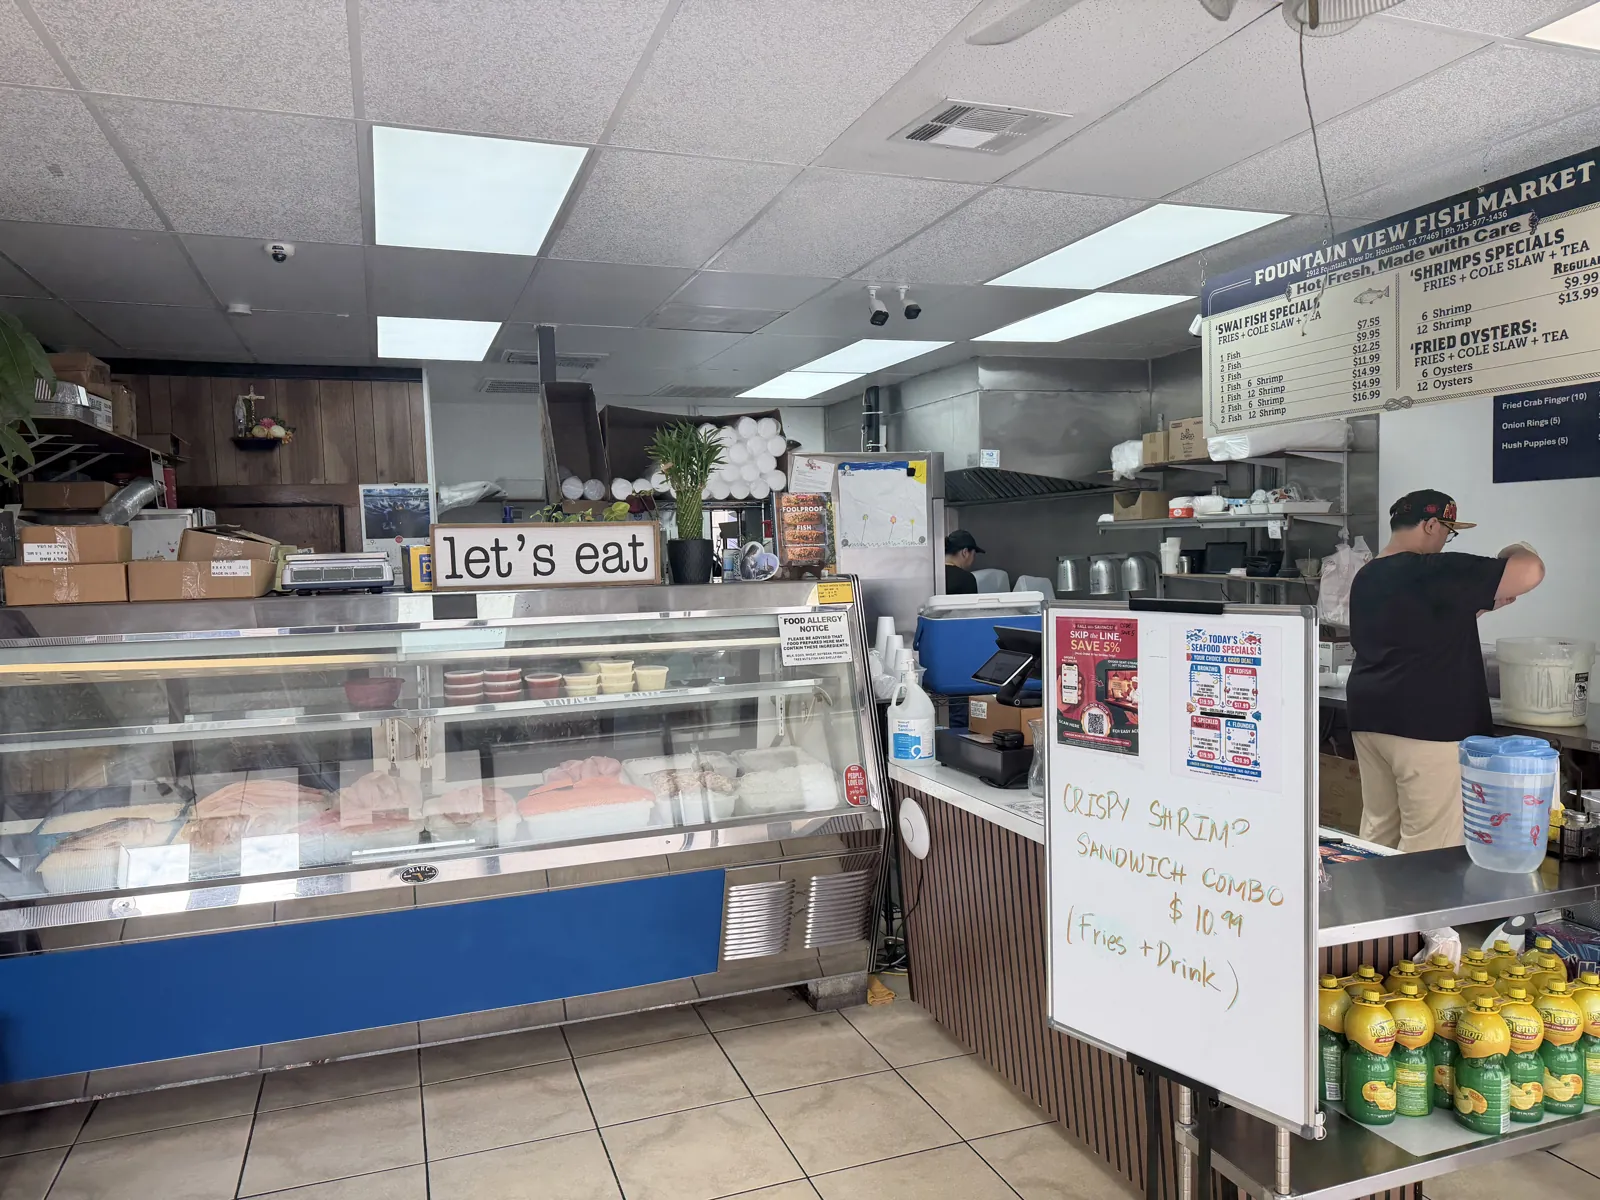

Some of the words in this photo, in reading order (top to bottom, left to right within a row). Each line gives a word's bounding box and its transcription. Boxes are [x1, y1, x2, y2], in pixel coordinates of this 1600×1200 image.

[1254, 241, 1348, 286] FOUNTAIN
[1352, 221, 1409, 254] VIEW
[1415, 200, 1472, 236] FISH
[1477, 160, 1596, 215] MARKET
[1306, 267, 1320, 278] 2912
[1348, 254, 1363, 265] View
[1408, 236, 1418, 246] TX
[1418, 231, 1440, 244] 77469
[1445, 226, 1456, 236] Ph
[1456, 210, 1508, 232] 713-977-1436
[1328, 264, 1376, 286] Fresh,
[1378, 247, 1425, 271] Made
[1429, 235, 1469, 255] with
[1474, 220, 1522, 243] Care
[1485, 228, 1565, 263] SPECIALS
[1423, 274, 1457, 292] FRIES
[1459, 275, 1467, 283] +
[1469, 262, 1504, 280] COLE
[1507, 251, 1545, 270] SLAW
[1549, 252, 1557, 260] +
[1561, 240, 1590, 257] TEA
[1416, 325, 1428, 335] 12
[1432, 315, 1472, 332] Shrimp
[1558, 286, 1599, 305] $13.99
[1421, 311, 1428, 321] 6
[1432, 302, 1472, 319] Shrimp
[1564, 271, 1599, 290] $9.99
[1218, 332, 1239, 346] FRIES
[1247, 324, 1269, 338] COLE
[1271, 317, 1294, 331] SLAW
[1244, 311, 1267, 329] FISH
[1460, 319, 1537, 347] OYSTERS:
[1220, 364, 1225, 373] 2
[1227, 361, 1242, 371] Fish
[1356, 328, 1380, 343] $9.95
[1227, 351, 1241, 361] Fish
[1357, 316, 1380, 331] $7.55
[1414, 352, 1445, 367] FRIES
[1448, 352, 1455, 360] +
[1457, 343, 1490, 359] COLE
[1492, 336, 1528, 353] SLAW
[1531, 337, 1539, 345] +
[1542, 329, 1569, 344] TEA
[1220, 374, 1225, 383] 3
[1227, 372, 1242, 382] Fish
[1352, 341, 1380, 355] $12.25
[1227, 382, 1242, 392] Fish
[1247, 379, 1252, 388] 6
[1256, 374, 1284, 387] Shrimp
[1353, 353, 1380, 367] $11.99
[1421, 369, 1428, 378] 6
[1433, 361, 1473, 377] Oysters
[1220, 405, 1225, 413] 2
[1228, 403, 1242, 413] Fish
[1248, 400, 1253, 409] 6
[1257, 395, 1285, 408] Shrimp
[1352, 377, 1381, 391] $14.99
[1227, 393, 1242, 403] Fish
[1247, 389, 1256, 398] 12
[1258, 384, 1285, 397] Shrimp
[1352, 365, 1381, 379] $14.99
[1416, 382, 1428, 391] 12
[1433, 375, 1473, 390] Oysters
[1502, 401, 1522, 410] Fried
[1523, 398, 1543, 407] Crab
[1544, 395, 1570, 406] Finger
[1571, 392, 1587, 403] (10)
[1220, 416, 1225, 424] 2
[1228, 413, 1243, 423] Fish
[1248, 411, 1256, 420] 12
[1259, 406, 1287, 419] Shrimp
[1352, 389, 1381, 403] $16.99
[1502, 420, 1525, 430] Onion
[1526, 417, 1549, 428] Rings
[1550, 416, 1561, 426] (5)
[1501, 441, 1522, 450] Hush
[1523, 437, 1556, 449] Puppies
[1557, 436, 1569, 446] (5)
[782, 505, 823, 513] FOOLPROOF
[442, 533, 556, 580] let's
[575, 533, 648, 575] eat
[783, 617, 806, 625] FOOD
[807, 615, 843, 624] ALLERGY
[799, 625, 829, 633] NOTICE
[1070, 630, 1089, 639] SKIP
[1099, 632, 1122, 642] LINE,
[1070, 639, 1100, 652] SAVE
[1103, 641, 1121, 653] 5%
[1191, 643, 1221, 653] SEAFOOD
[1222, 644, 1257, 655] SPECIALS!
[1208, 634, 1238, 645] TODAY'S
[1063, 783, 1130, 821] CRISPY
[1149, 800, 1251, 848] SHRIMP
[1076, 831, 1187, 885] SANDWICH
[1202, 867, 1284, 906] COMBO
[1066, 905, 1127, 955] (Fries
[1169, 892, 1183, 924] $
[1195, 904, 1243, 938] 10.99
